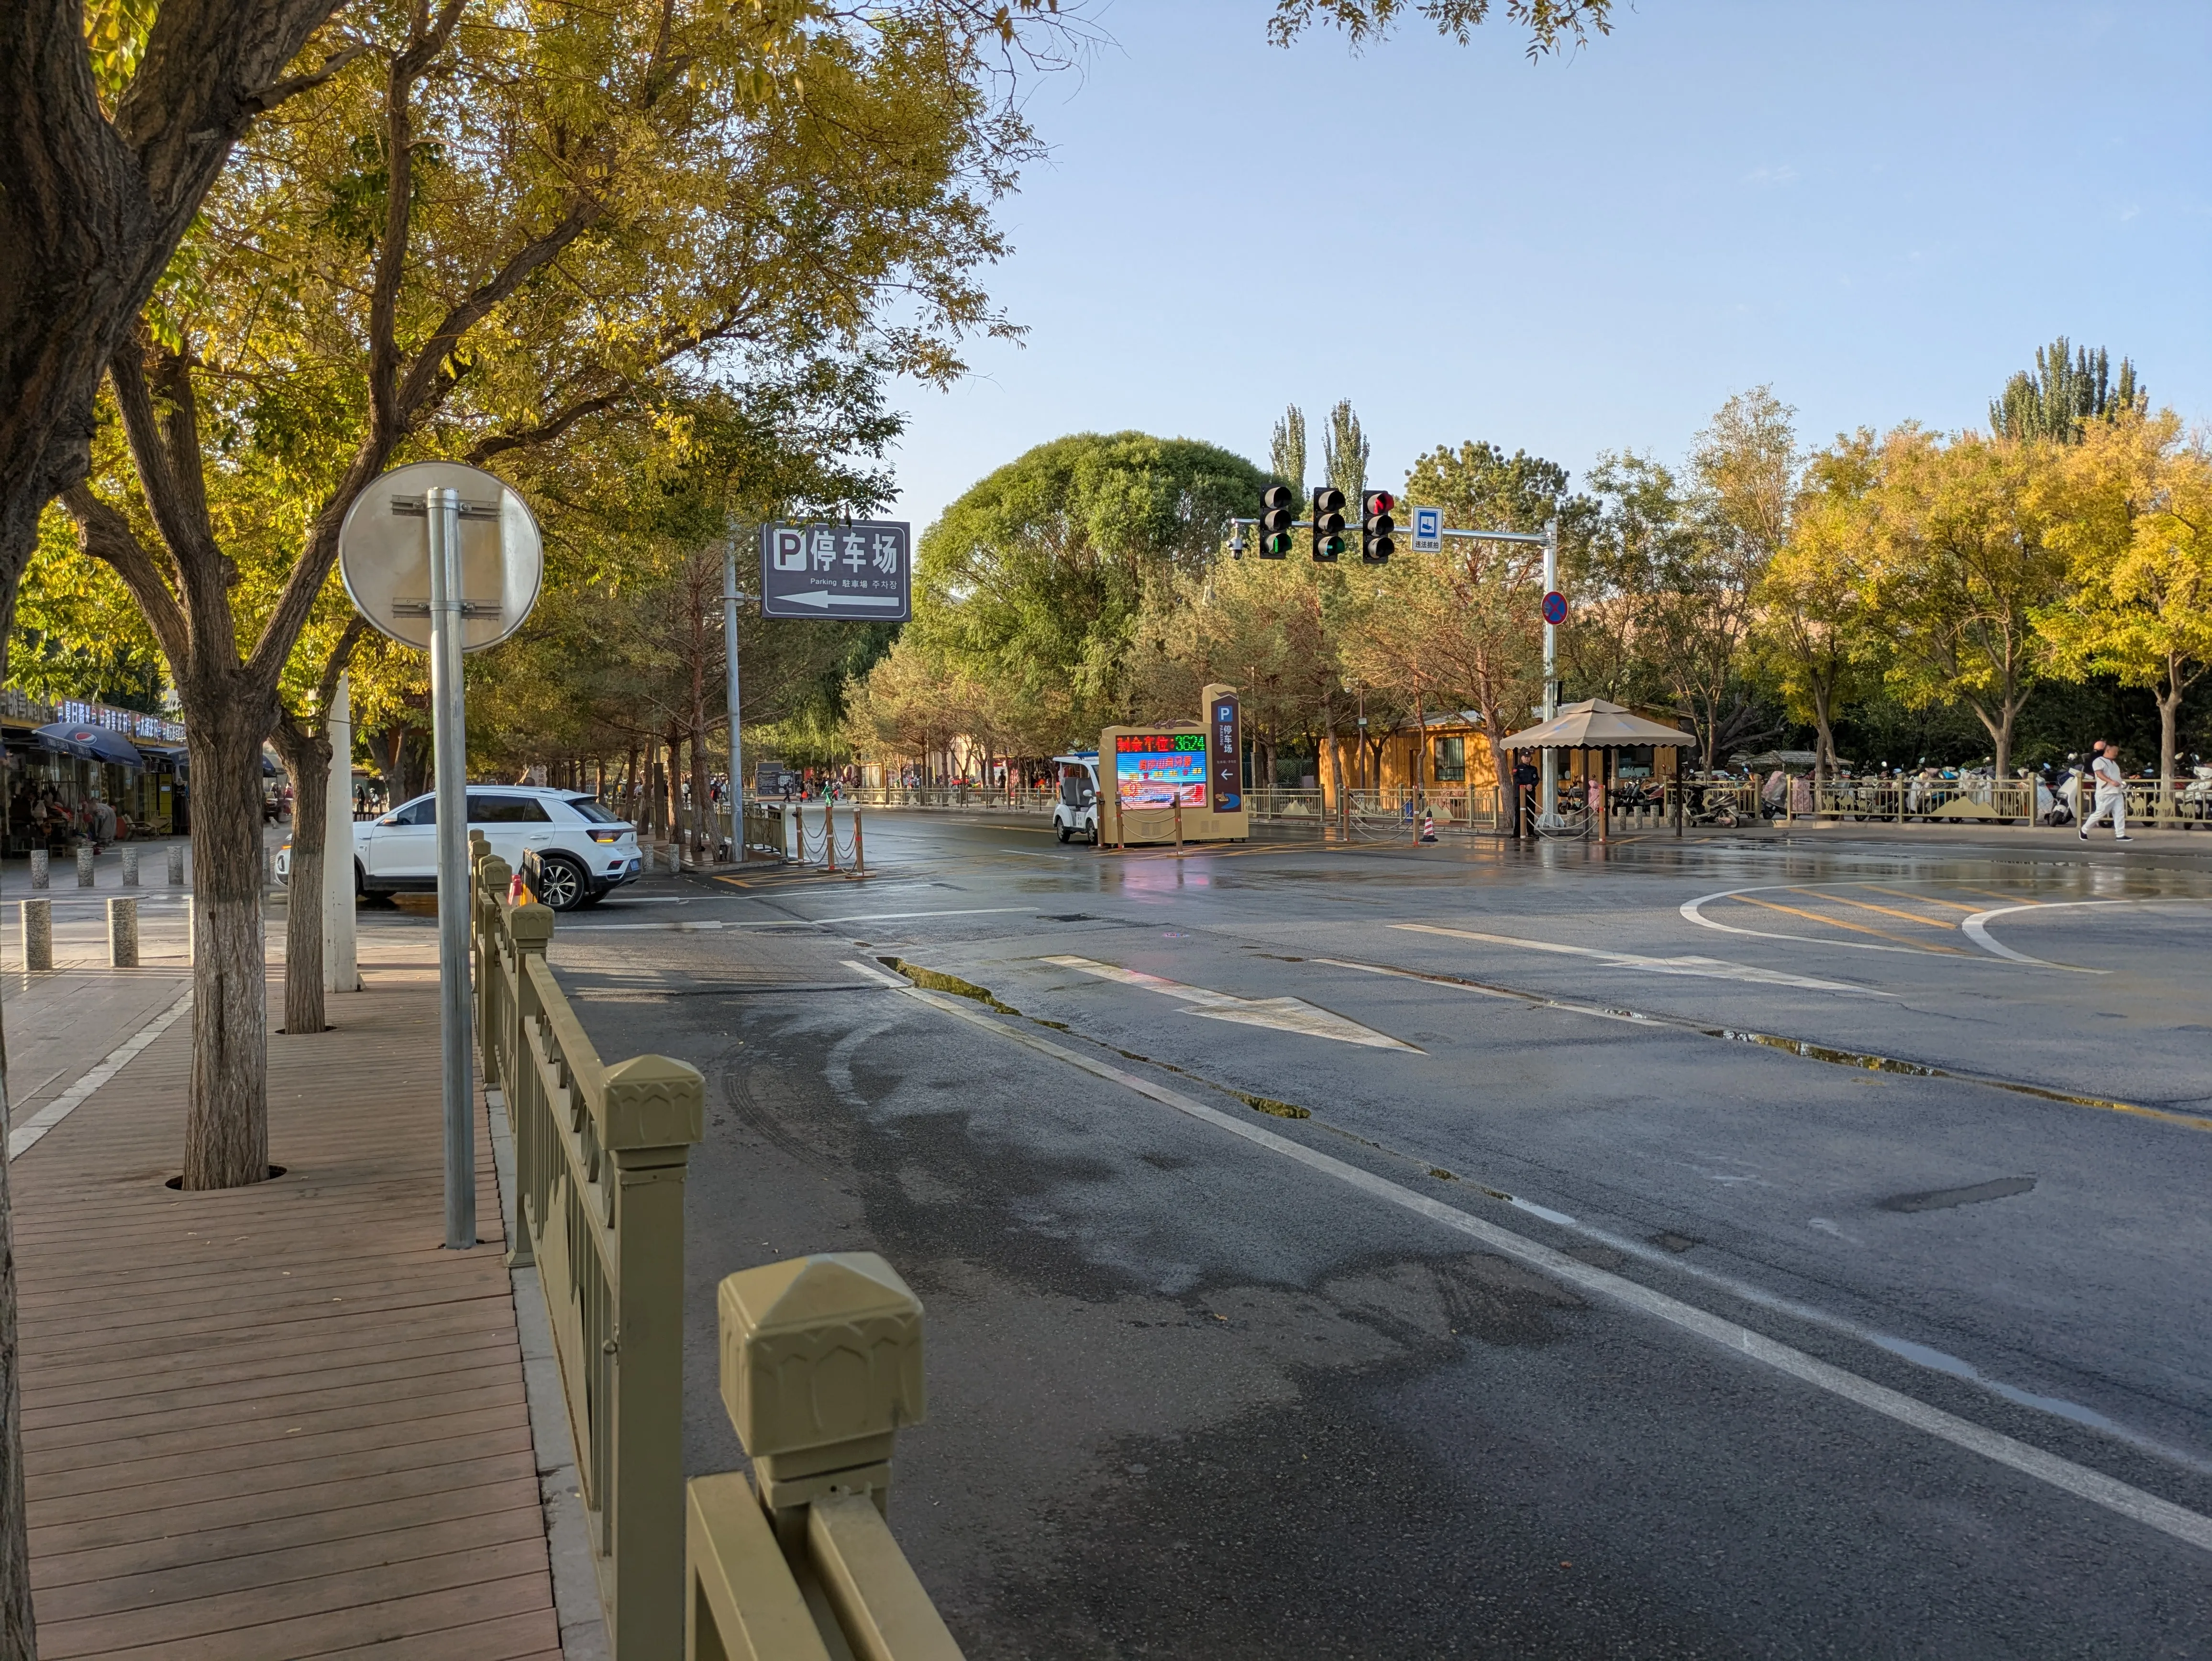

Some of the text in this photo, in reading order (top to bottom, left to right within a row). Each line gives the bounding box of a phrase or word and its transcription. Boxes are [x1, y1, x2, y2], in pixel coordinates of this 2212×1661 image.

[1415, 541, 1439, 549] 违法抓拍
[779, 530, 897, 574] P 停车场
[810, 578, 897, 589] Parking 駐車場 주차장
[1220, 708, 1230, 720] P
[1223, 725, 1232, 753] 停车场
